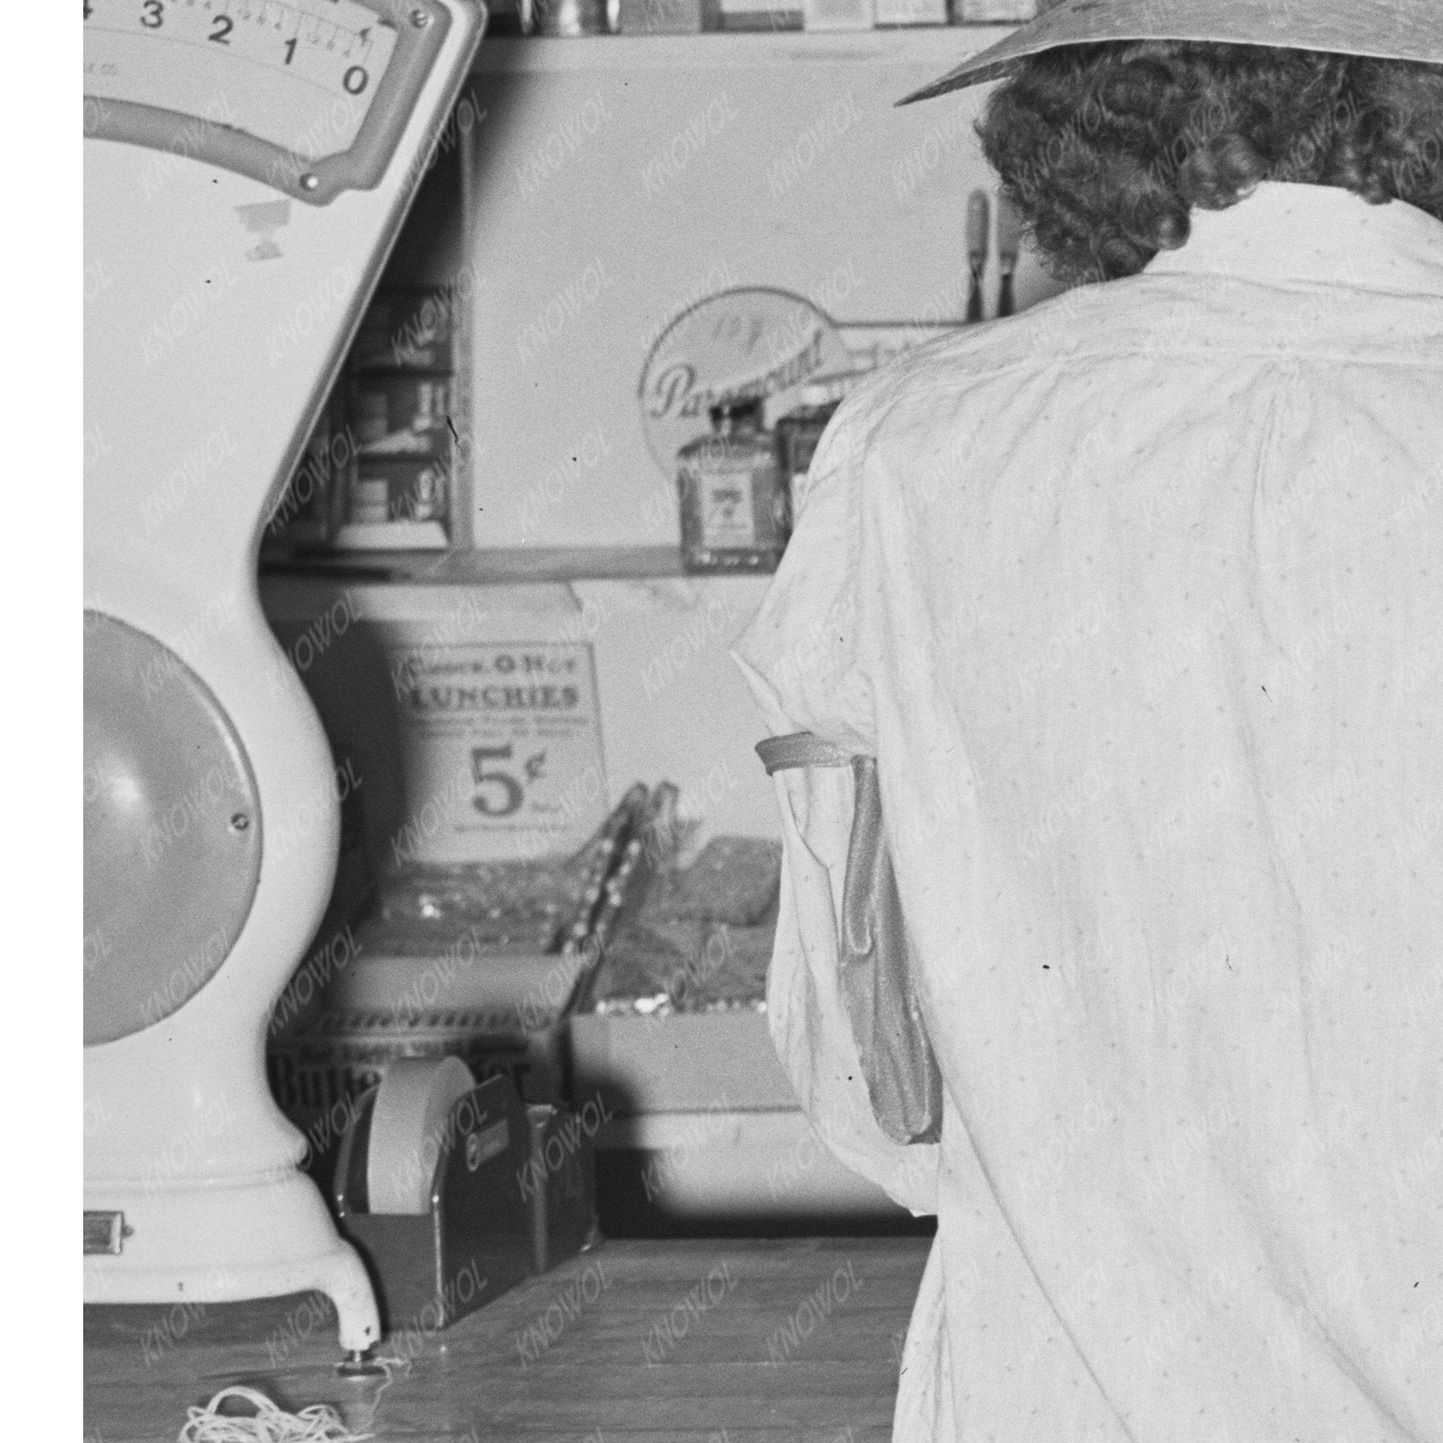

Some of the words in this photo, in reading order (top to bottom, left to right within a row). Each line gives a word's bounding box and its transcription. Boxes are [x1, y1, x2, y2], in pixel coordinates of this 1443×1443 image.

[140, 0, 165, 29] 3
[207, 14, 235, 45] 2
[284, 37, 298, 66] 1
[341, 65, 369, 96] 0
[409, 685, 580, 712] LUNCHIES
[471, 742, 548, 820] 5¢
